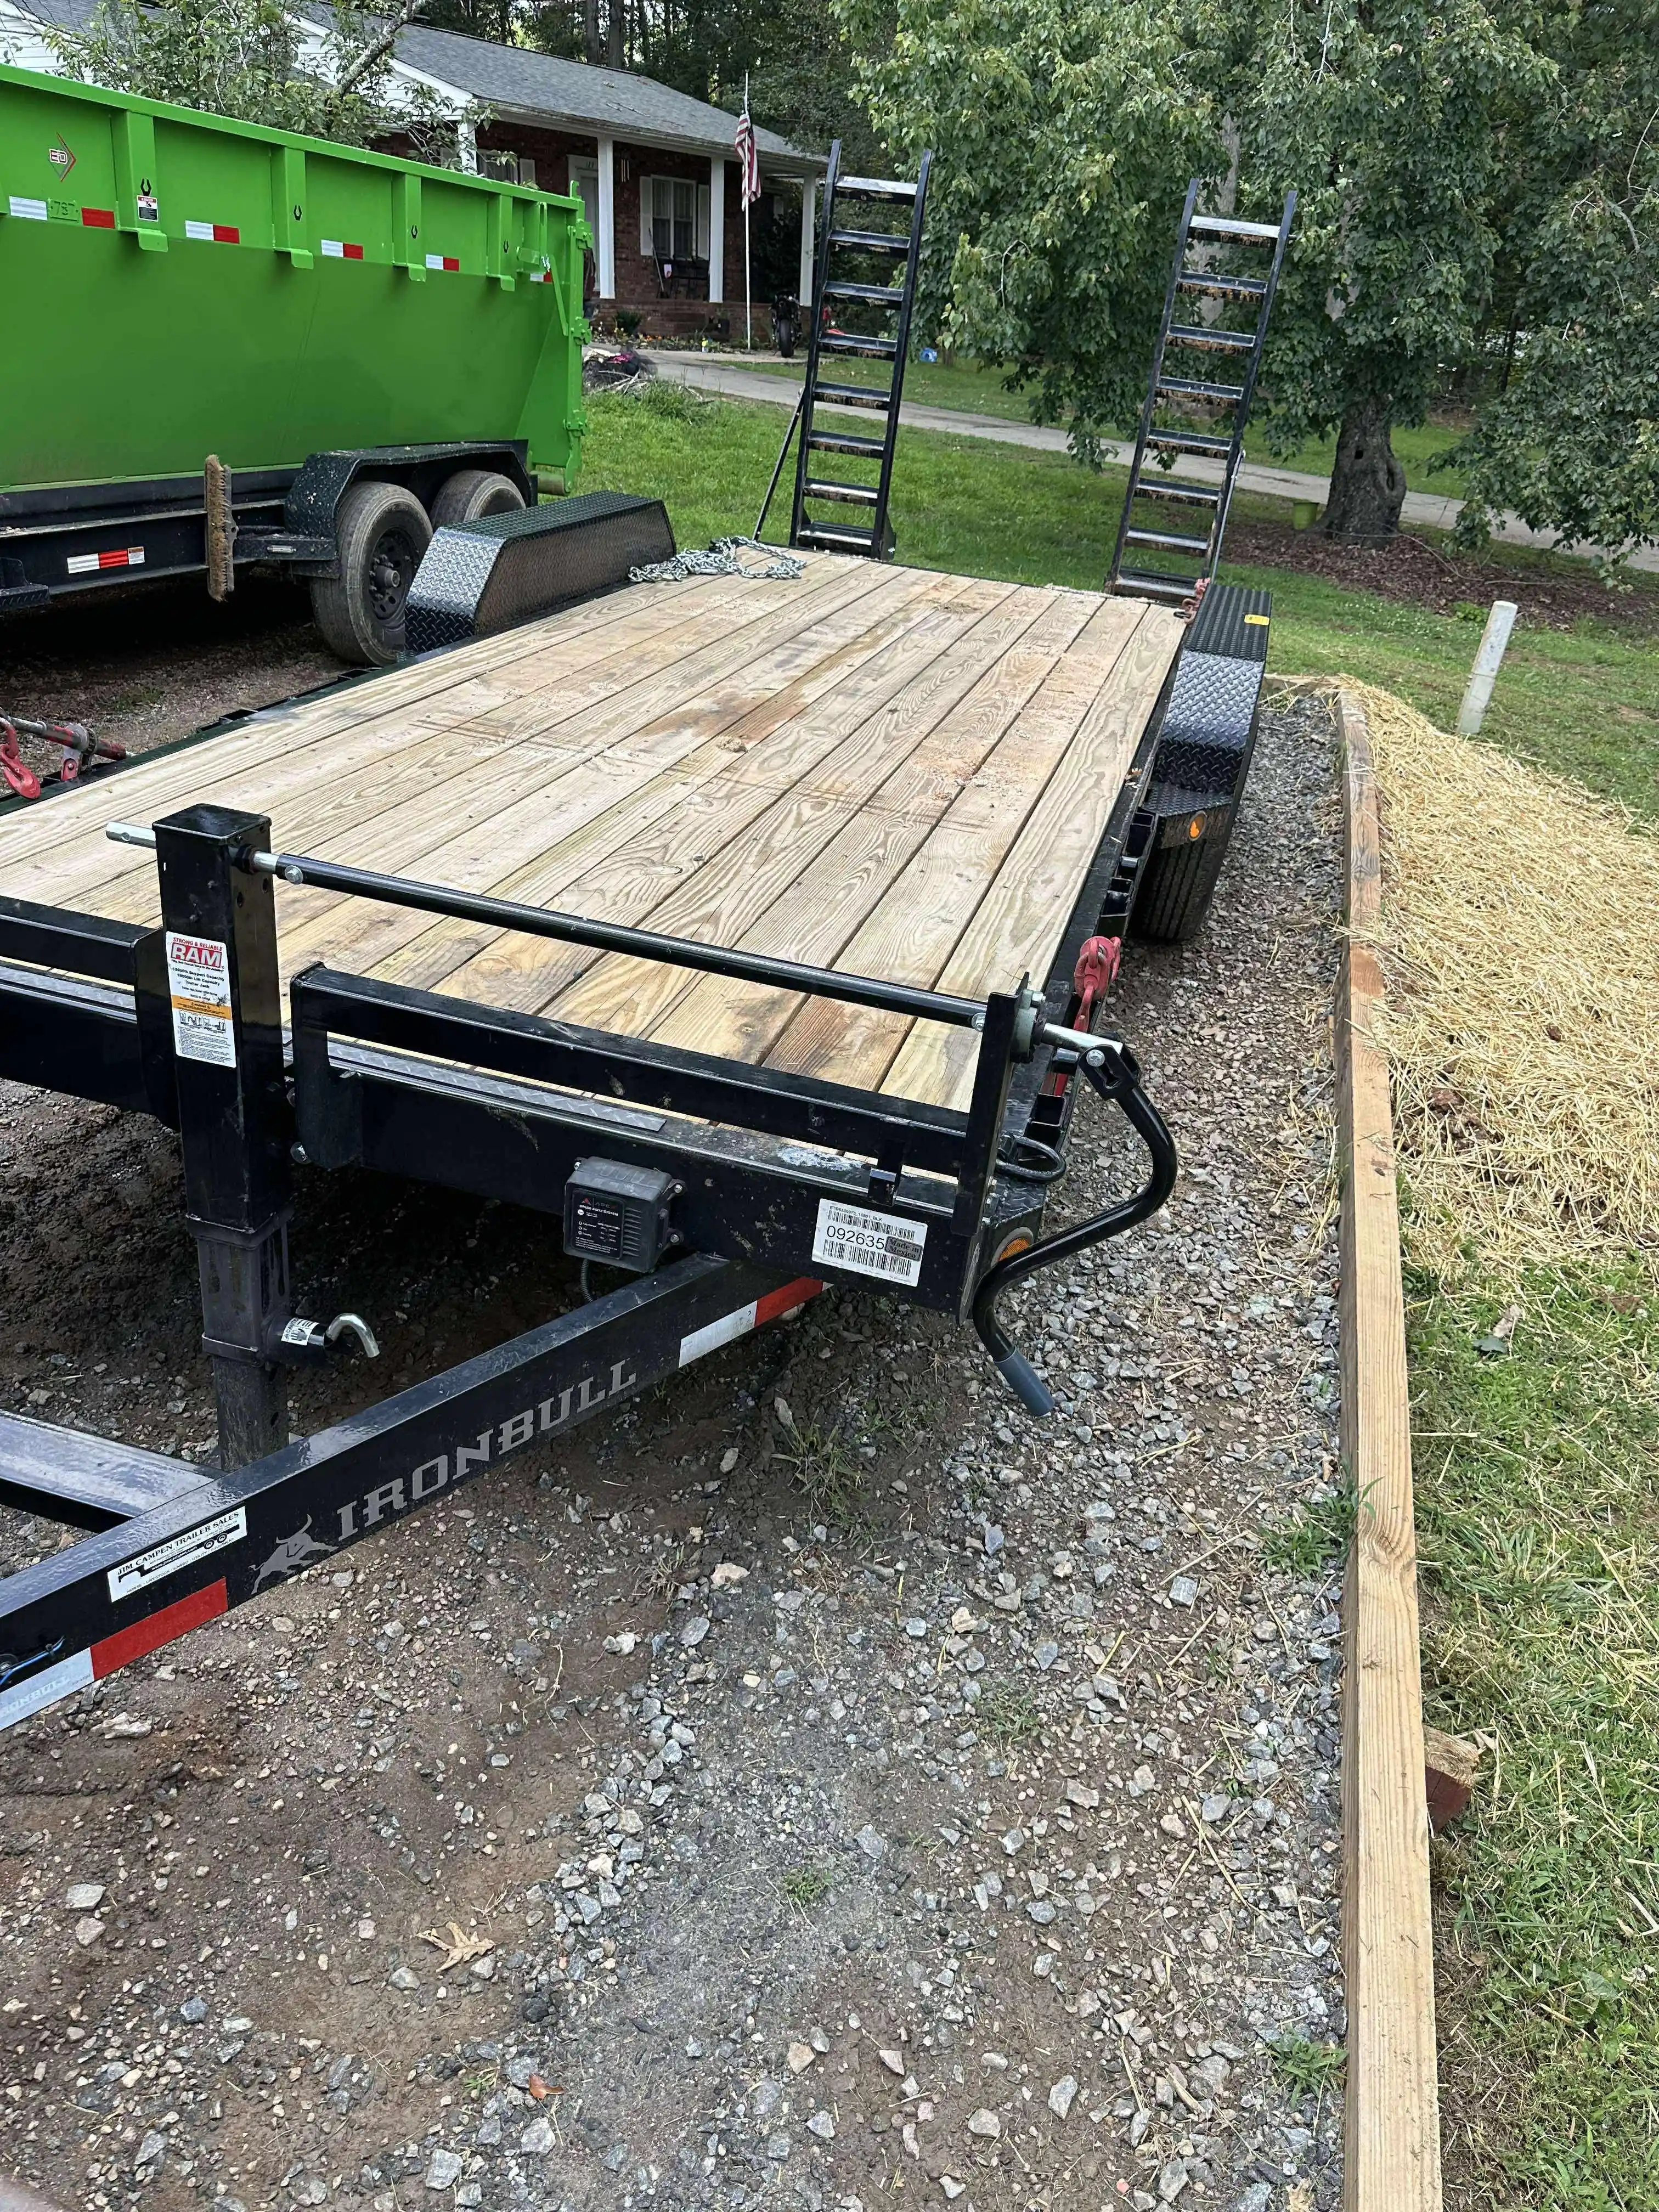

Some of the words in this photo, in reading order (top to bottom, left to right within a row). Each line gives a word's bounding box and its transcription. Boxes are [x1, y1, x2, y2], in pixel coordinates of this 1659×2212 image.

[173, 937, 193, 945] STRONG
[199, 943, 223, 951] RELIABLE
[172, 944, 221, 967] RAM
[202, 978, 220, 986] Capacity
[827, 1225, 884, 1250] 092635
[889, 1239, 910, 1249] Made
[889, 1245, 916, 1259] Mexico
[336, 1359, 637, 1541] IRONBULL
[117, 1563, 133, 1575] JIM
[136, 1544, 172, 1565] CAMPEN
[175, 1525, 211, 1547] TRAILER
[213, 1512, 239, 1528] SALES
[127, 1584, 142, 1593] HORSE
